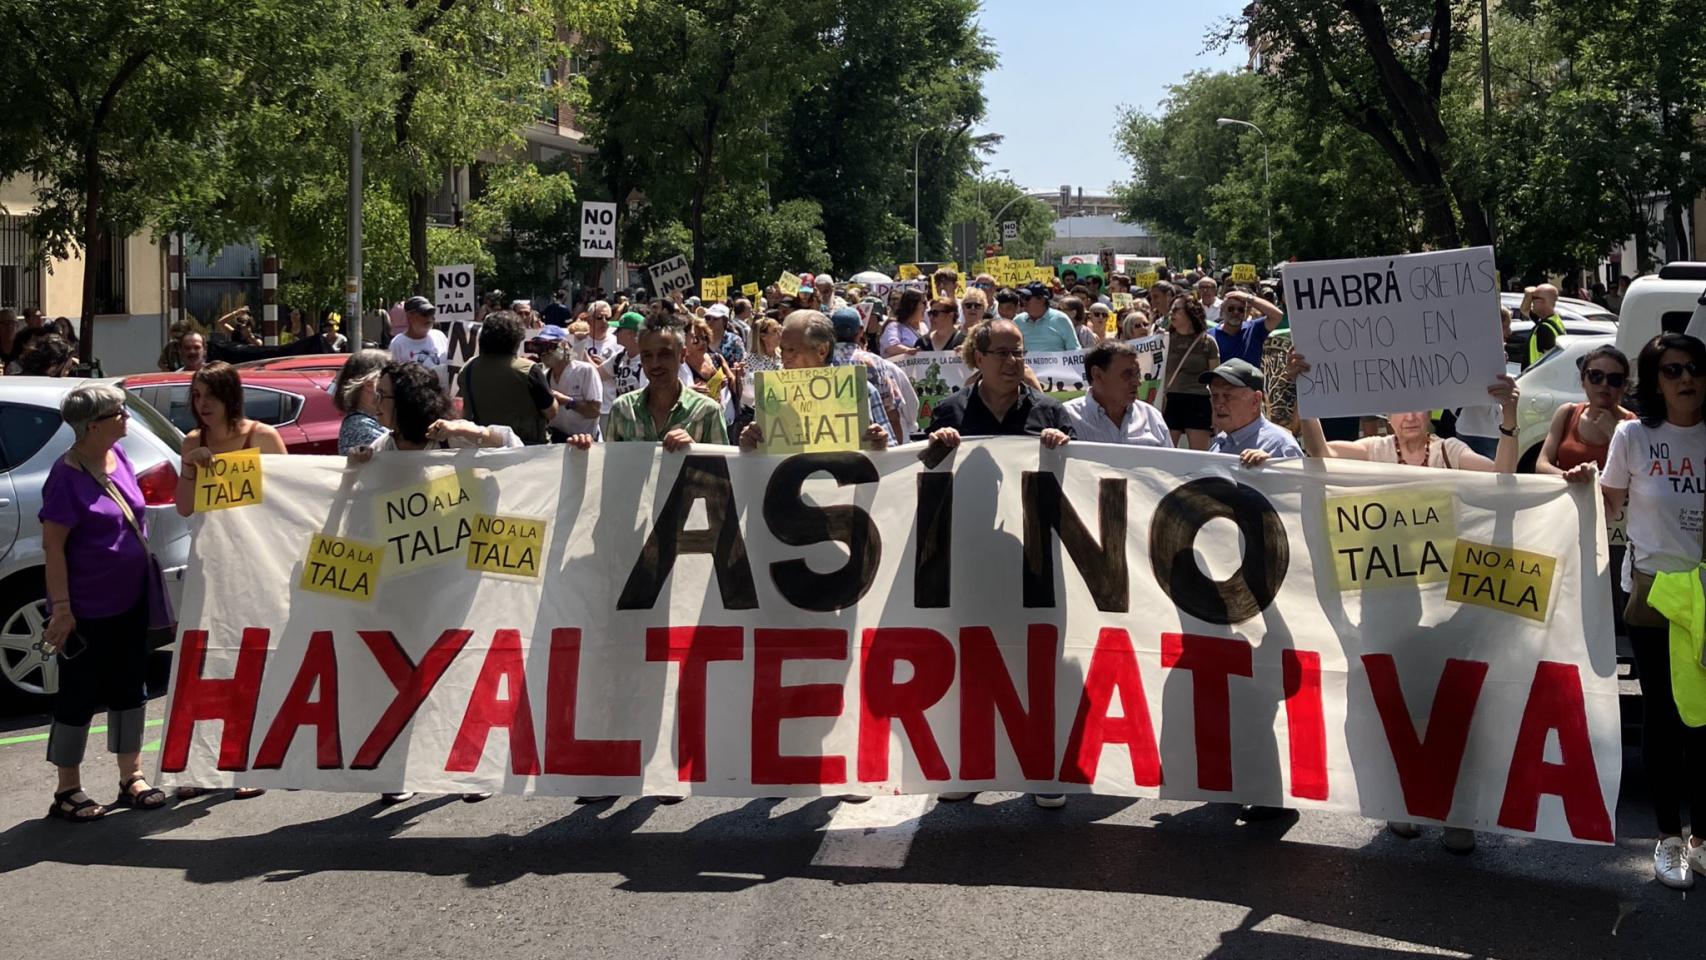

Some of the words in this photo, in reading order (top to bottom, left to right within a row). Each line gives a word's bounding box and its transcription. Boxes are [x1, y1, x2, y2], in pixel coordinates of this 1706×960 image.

[584, 209, 613, 225] NO
[582, 239, 613, 250] TALA
[651, 256, 686, 278] TALA
[1003, 272, 1032, 282] TALA
[1234, 272, 1254, 280] TALA
[438, 272, 471, 289] NO
[660, 274, 690, 296] ¡NO!
[1293, 260, 1402, 310] HABRÁ
[1409, 260, 1495, 300] GRIETAS
[704, 289, 725, 298] TALA
[437, 302, 472, 315] TALA
[1318, 315, 1394, 352] COMO
[1423, 310, 1458, 344] EN
[907, 357, 930, 366] BARRIOS
[940, 357, 948, 365] LA
[1033, 357, 1058, 365] NEGOCIO
[1062, 355, 1085, 366] PAR
[1300, 362, 1340, 395] SAN
[1353, 351, 1469, 393] FERNANDO
[800, 401, 813, 413] NO
[1649, 443, 1670, 459] NO
[204, 458, 227, 478] NO
[230, 463, 240, 474] A
[242, 460, 255, 473] LA
[202, 479, 256, 506] TALA
[1668, 477, 1706, 493] TAL
[386, 492, 429, 525] NO
[432, 495, 446, 511] A
[448, 487, 470, 508] LA
[1336, 502, 1387, 533] NO
[1393, 510, 1408, 528] A
[1412, 506, 1440, 526] LA
[477, 518, 506, 535] NO
[507, 523, 517, 536] A
[520, 524, 537, 540] LA
[318, 538, 345, 558] NO
[346, 549, 356, 561] A
[357, 548, 374, 565] LA
[388, 517, 472, 565] TALA
[1021, 470, 1290, 624] NO
[470, 541, 535, 571] TALA
[1338, 540, 1448, 582] TALA
[1465, 548, 1501, 569] NO
[1504, 556, 1515, 571] A
[1520, 559, 1542, 577] LA
[309, 561, 369, 596] TALA
[1457, 572, 1539, 612] TALA
